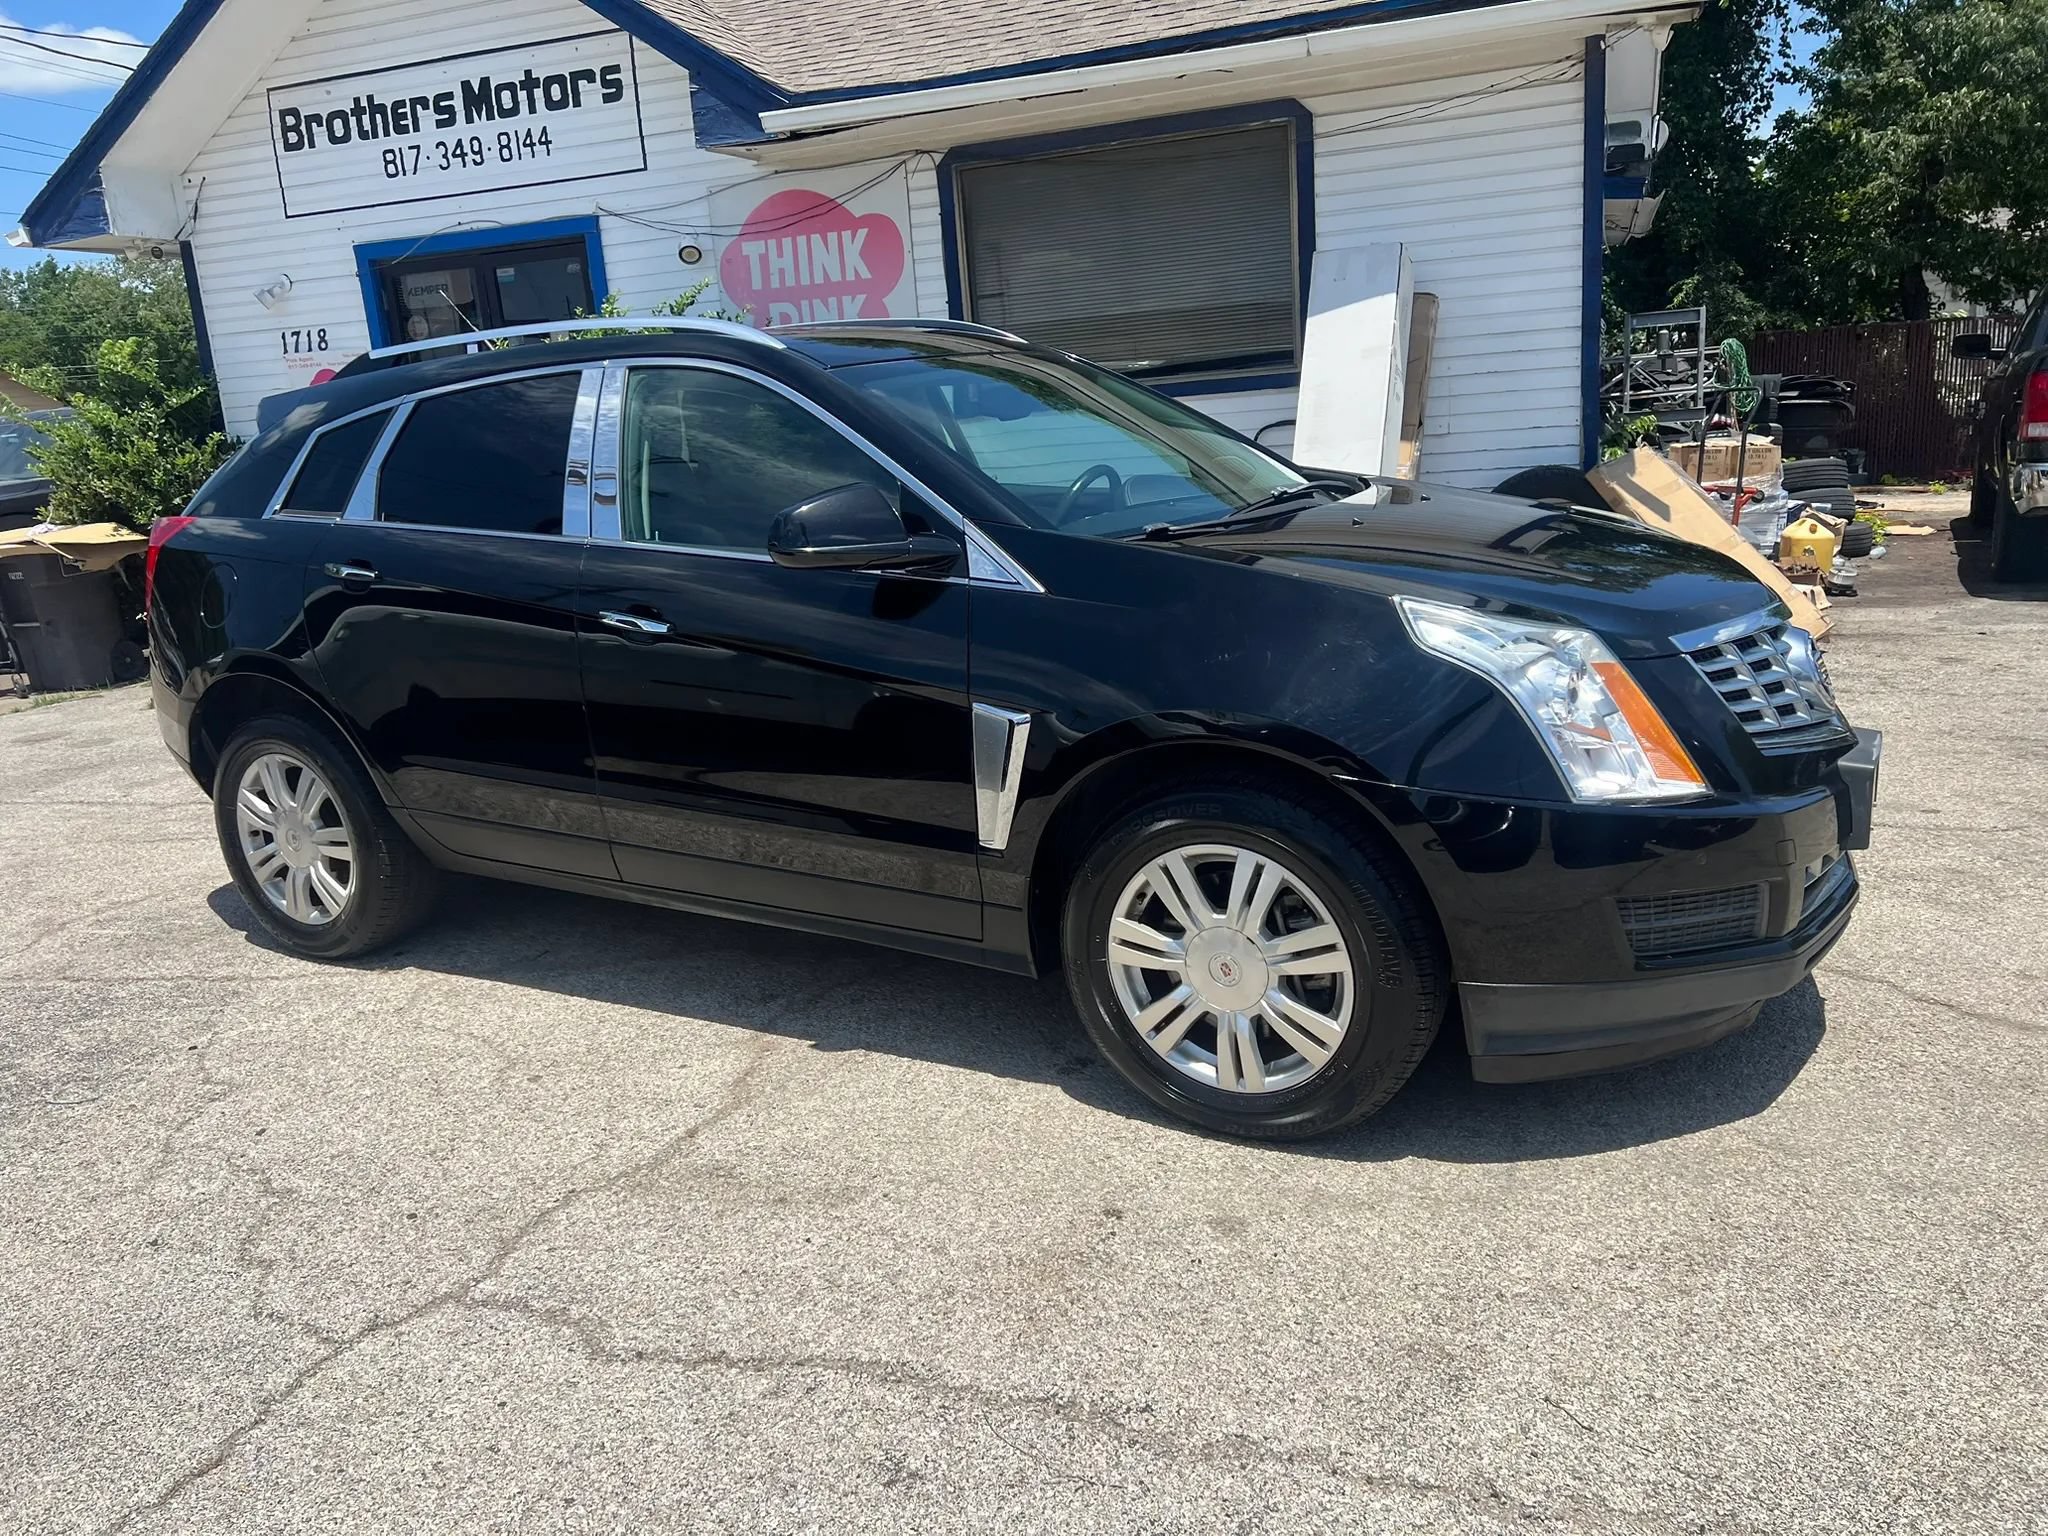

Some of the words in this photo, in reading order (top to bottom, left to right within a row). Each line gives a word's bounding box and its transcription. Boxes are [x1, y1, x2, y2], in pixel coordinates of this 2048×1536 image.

[279, 90, 457, 152] Brothers
[460, 63, 624, 125] Motors
[741, 227, 872, 290] THINK
[281, 328, 328, 355] 1718
